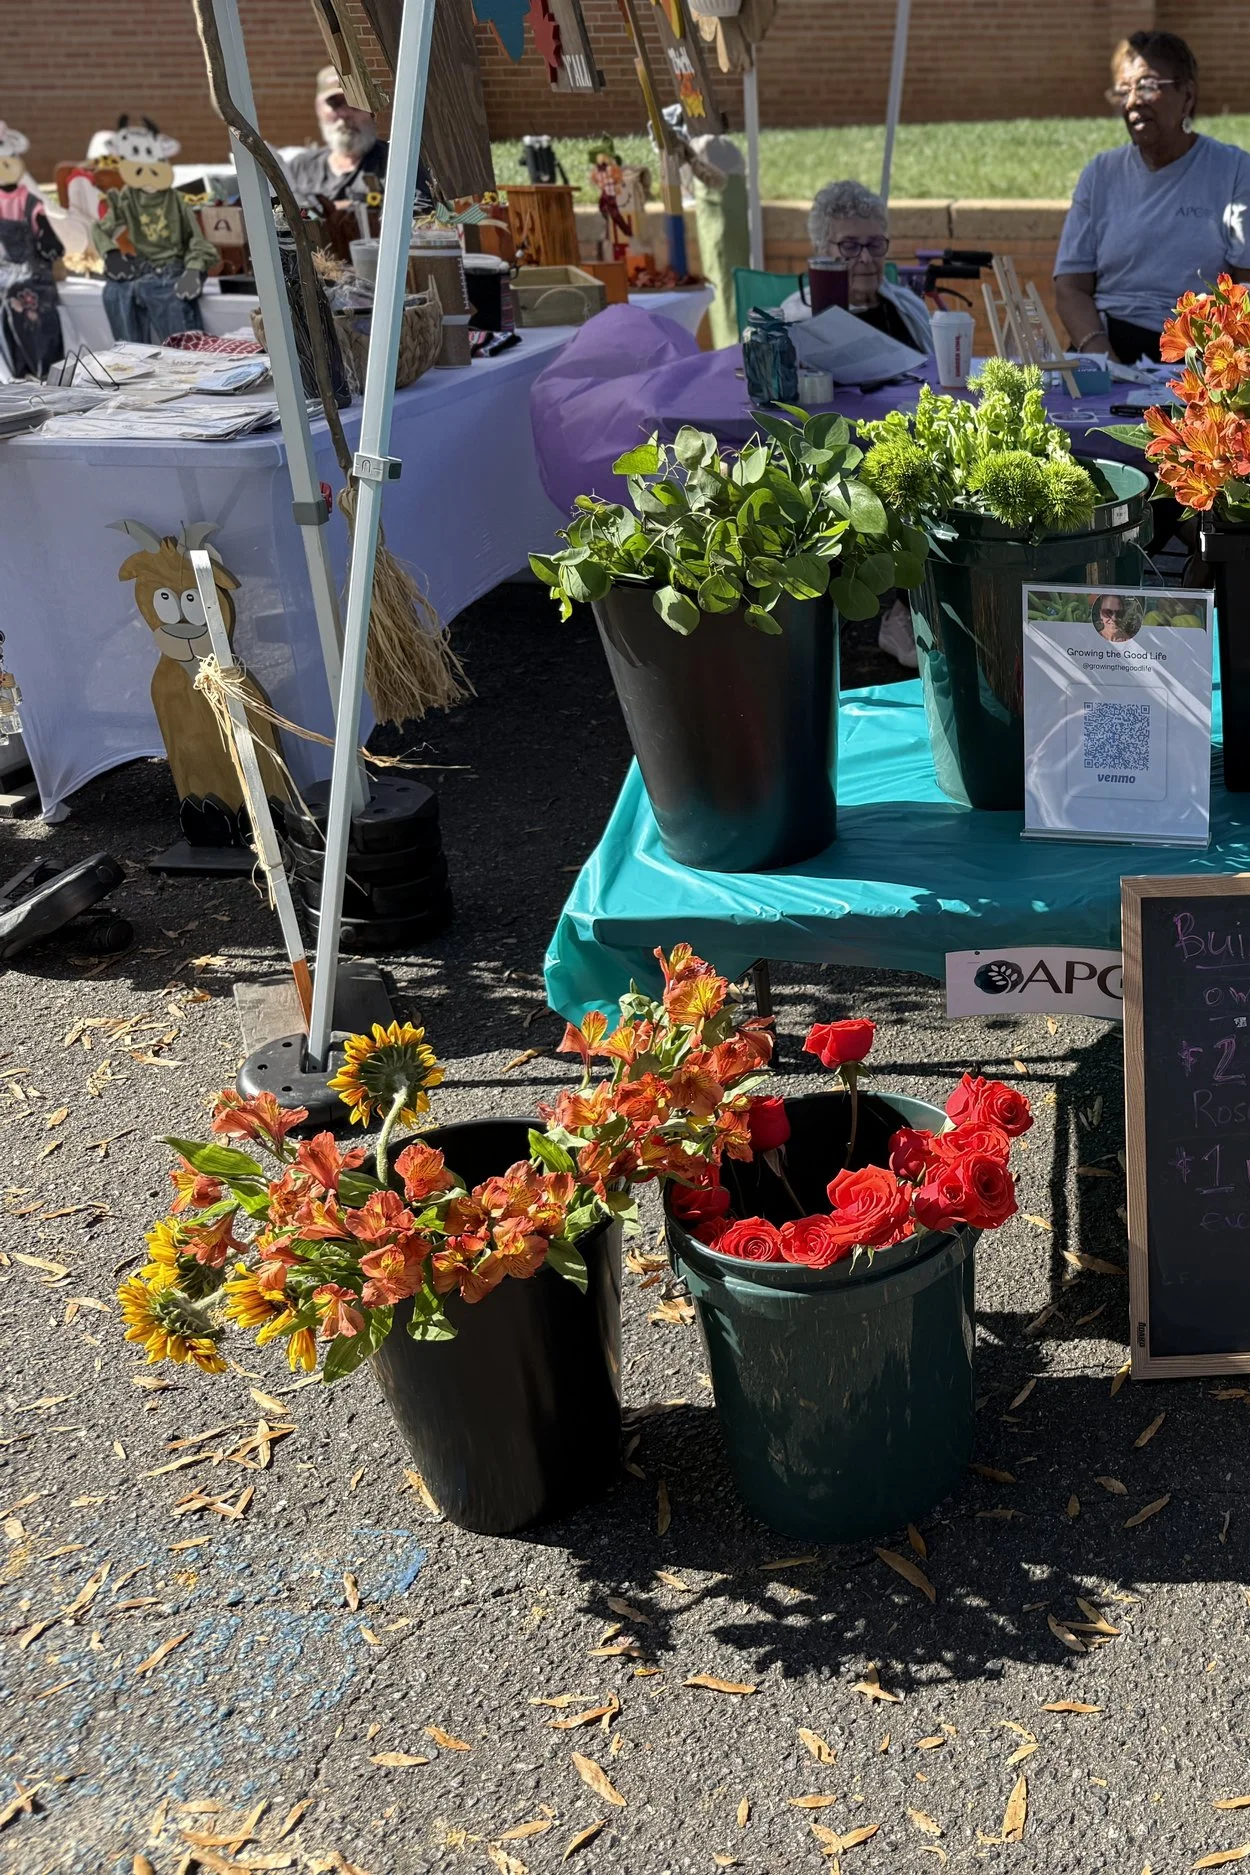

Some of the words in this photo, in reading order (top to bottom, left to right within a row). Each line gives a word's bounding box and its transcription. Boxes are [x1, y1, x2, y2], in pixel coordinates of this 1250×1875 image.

[1067, 648, 1104, 660] Growing
[1106, 650, 1122, 659] the
[1124, 651, 1148, 660] Good
[1150, 652, 1167, 661] Life
[1082, 663, 1152, 673] @growingthegoodlife
[1097, 773, 1136, 784] venmo
